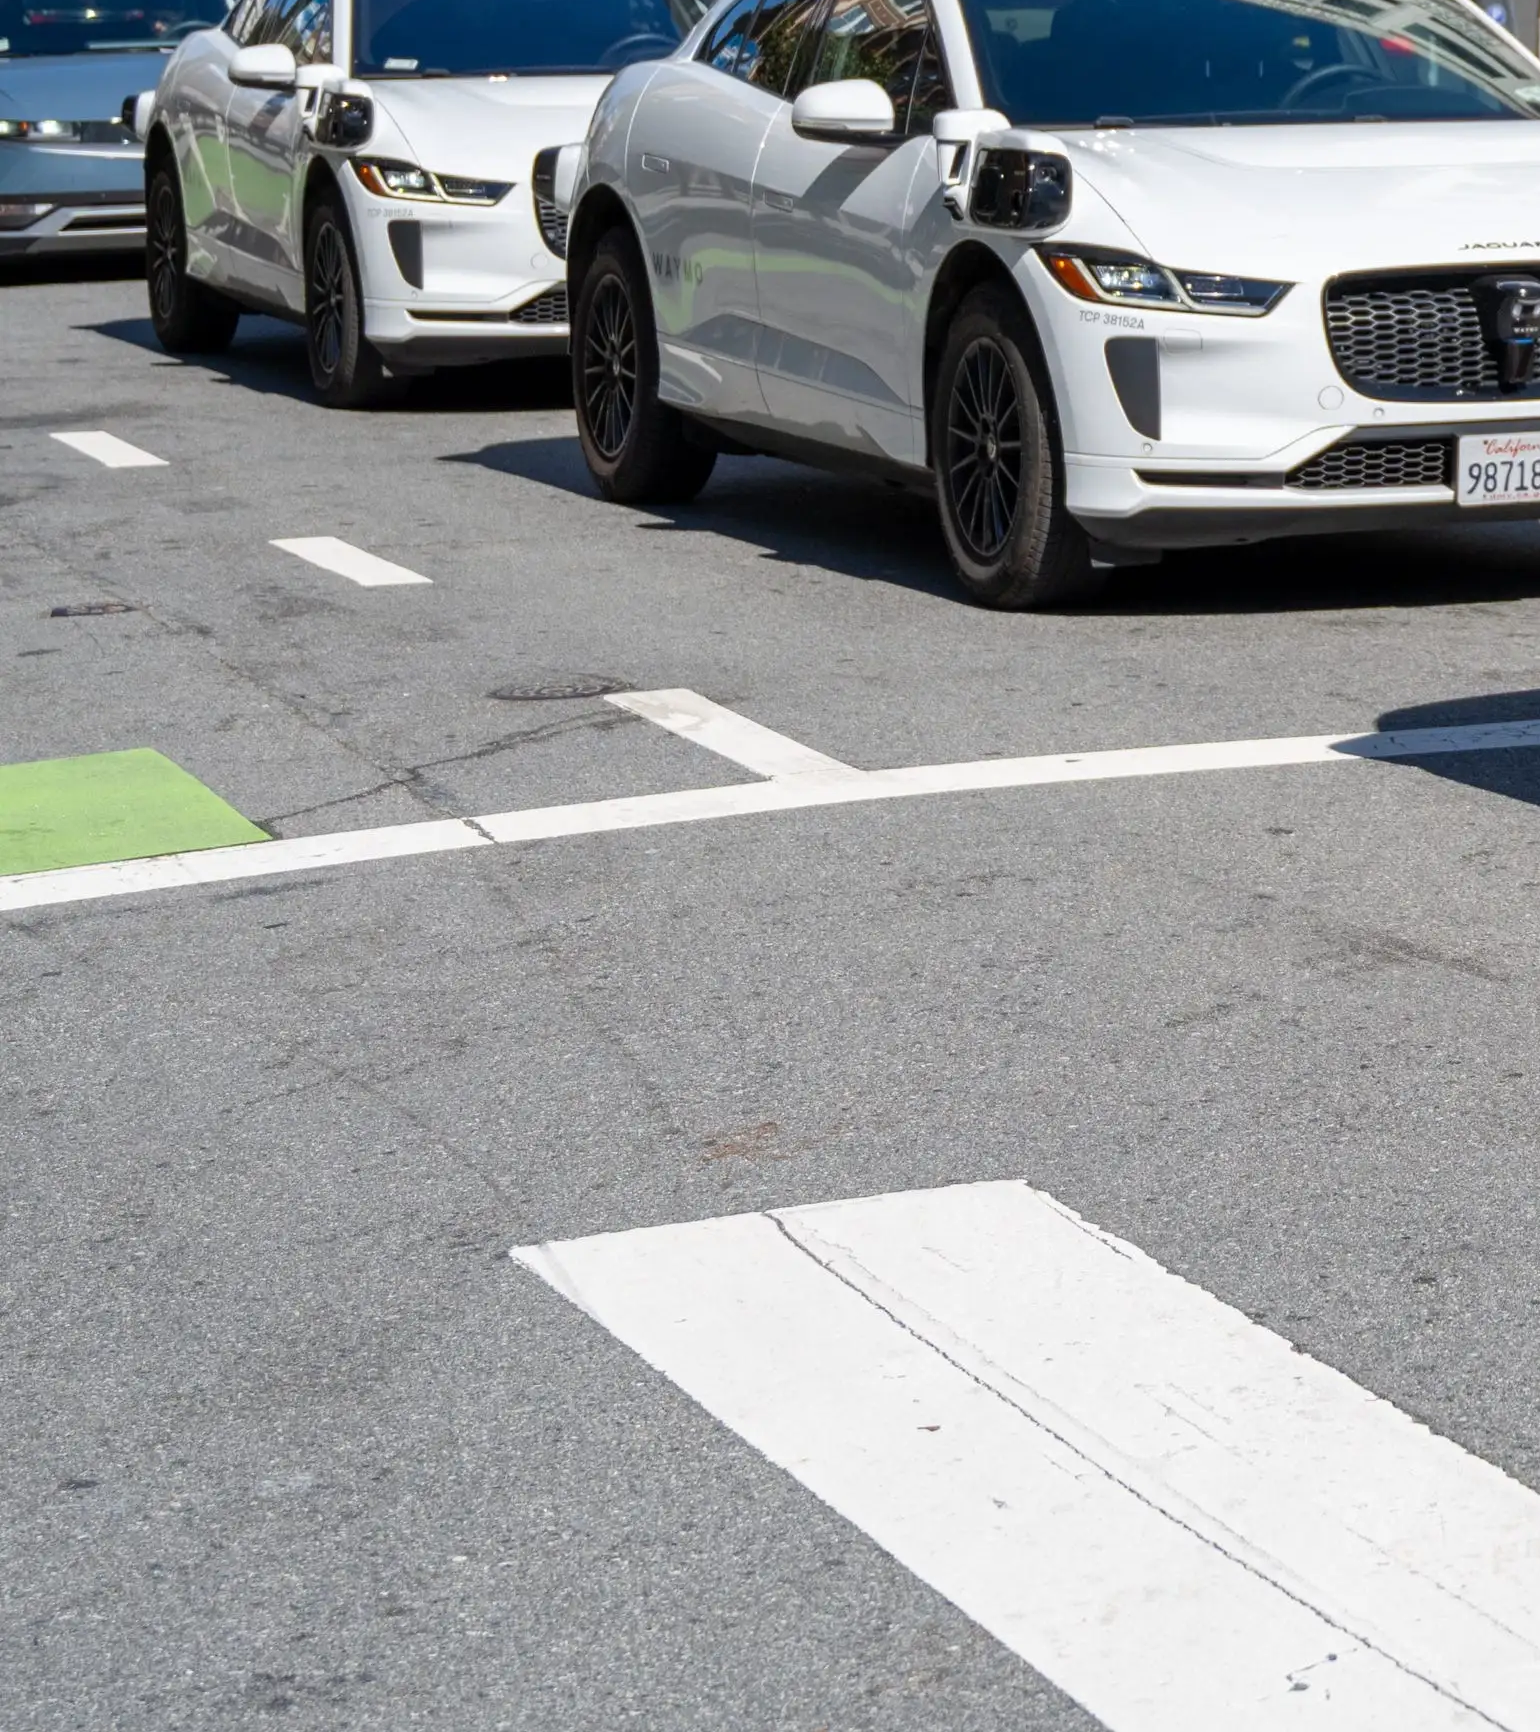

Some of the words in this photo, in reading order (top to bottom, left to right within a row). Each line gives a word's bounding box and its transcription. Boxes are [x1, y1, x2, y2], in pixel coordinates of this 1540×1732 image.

[652, 252, 703, 286] WAYMO
[1079, 310, 1101, 323] TCP
[1103, 313, 1145, 329] 38152A
